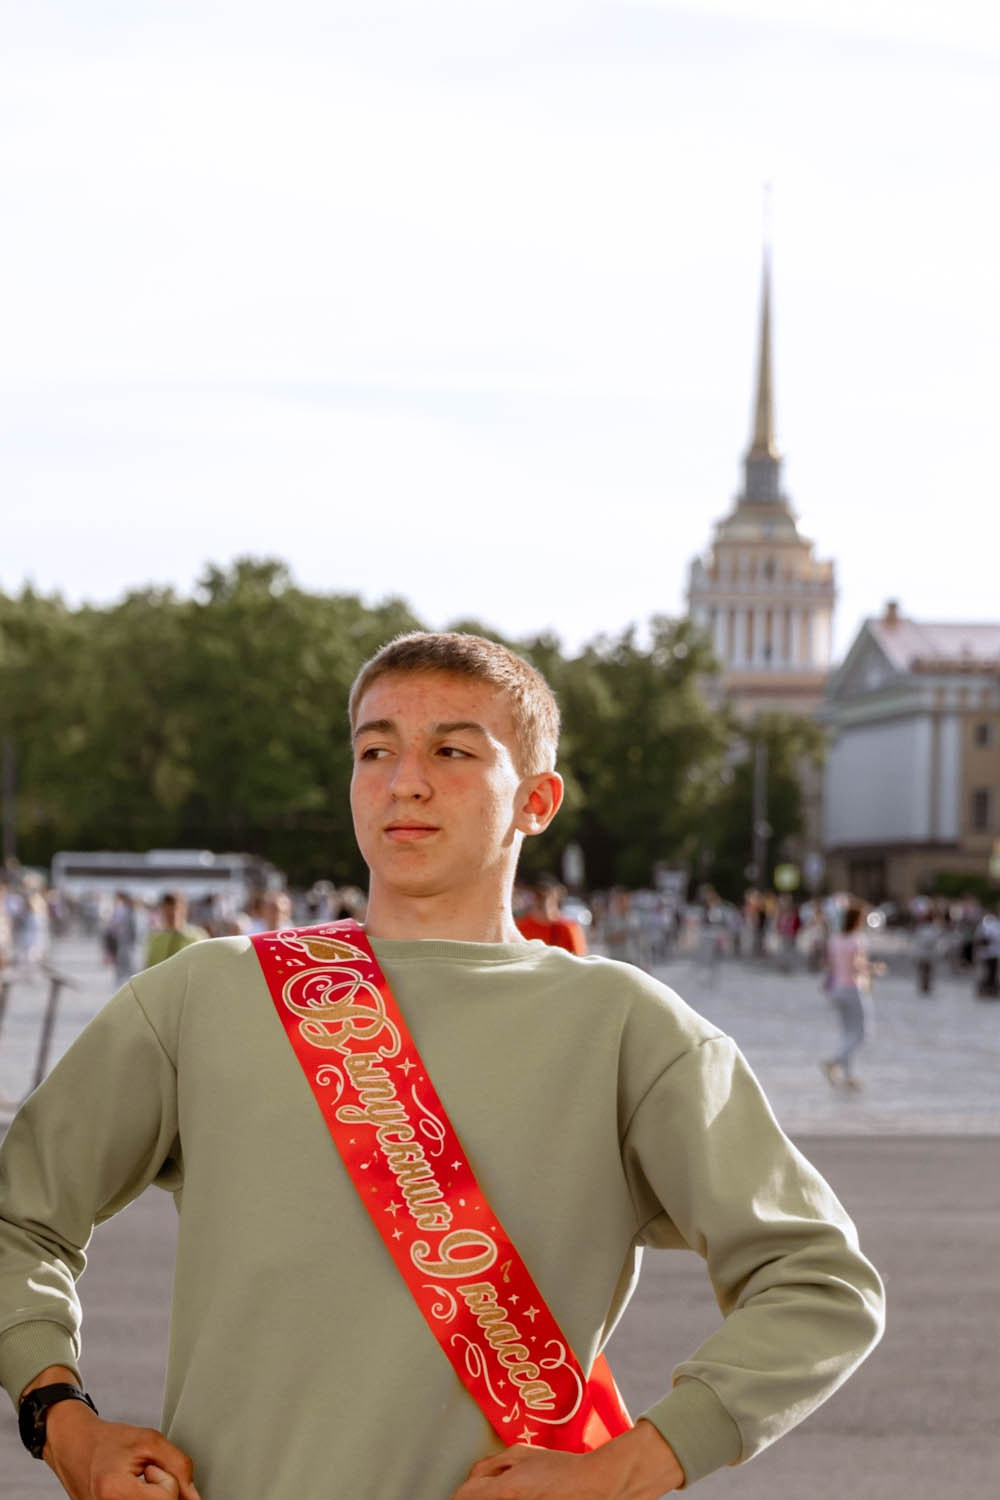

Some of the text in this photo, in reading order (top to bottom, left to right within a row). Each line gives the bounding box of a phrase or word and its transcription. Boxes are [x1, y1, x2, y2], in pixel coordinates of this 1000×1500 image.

[281, 966, 557, 1411] Выпускник 9 класса
